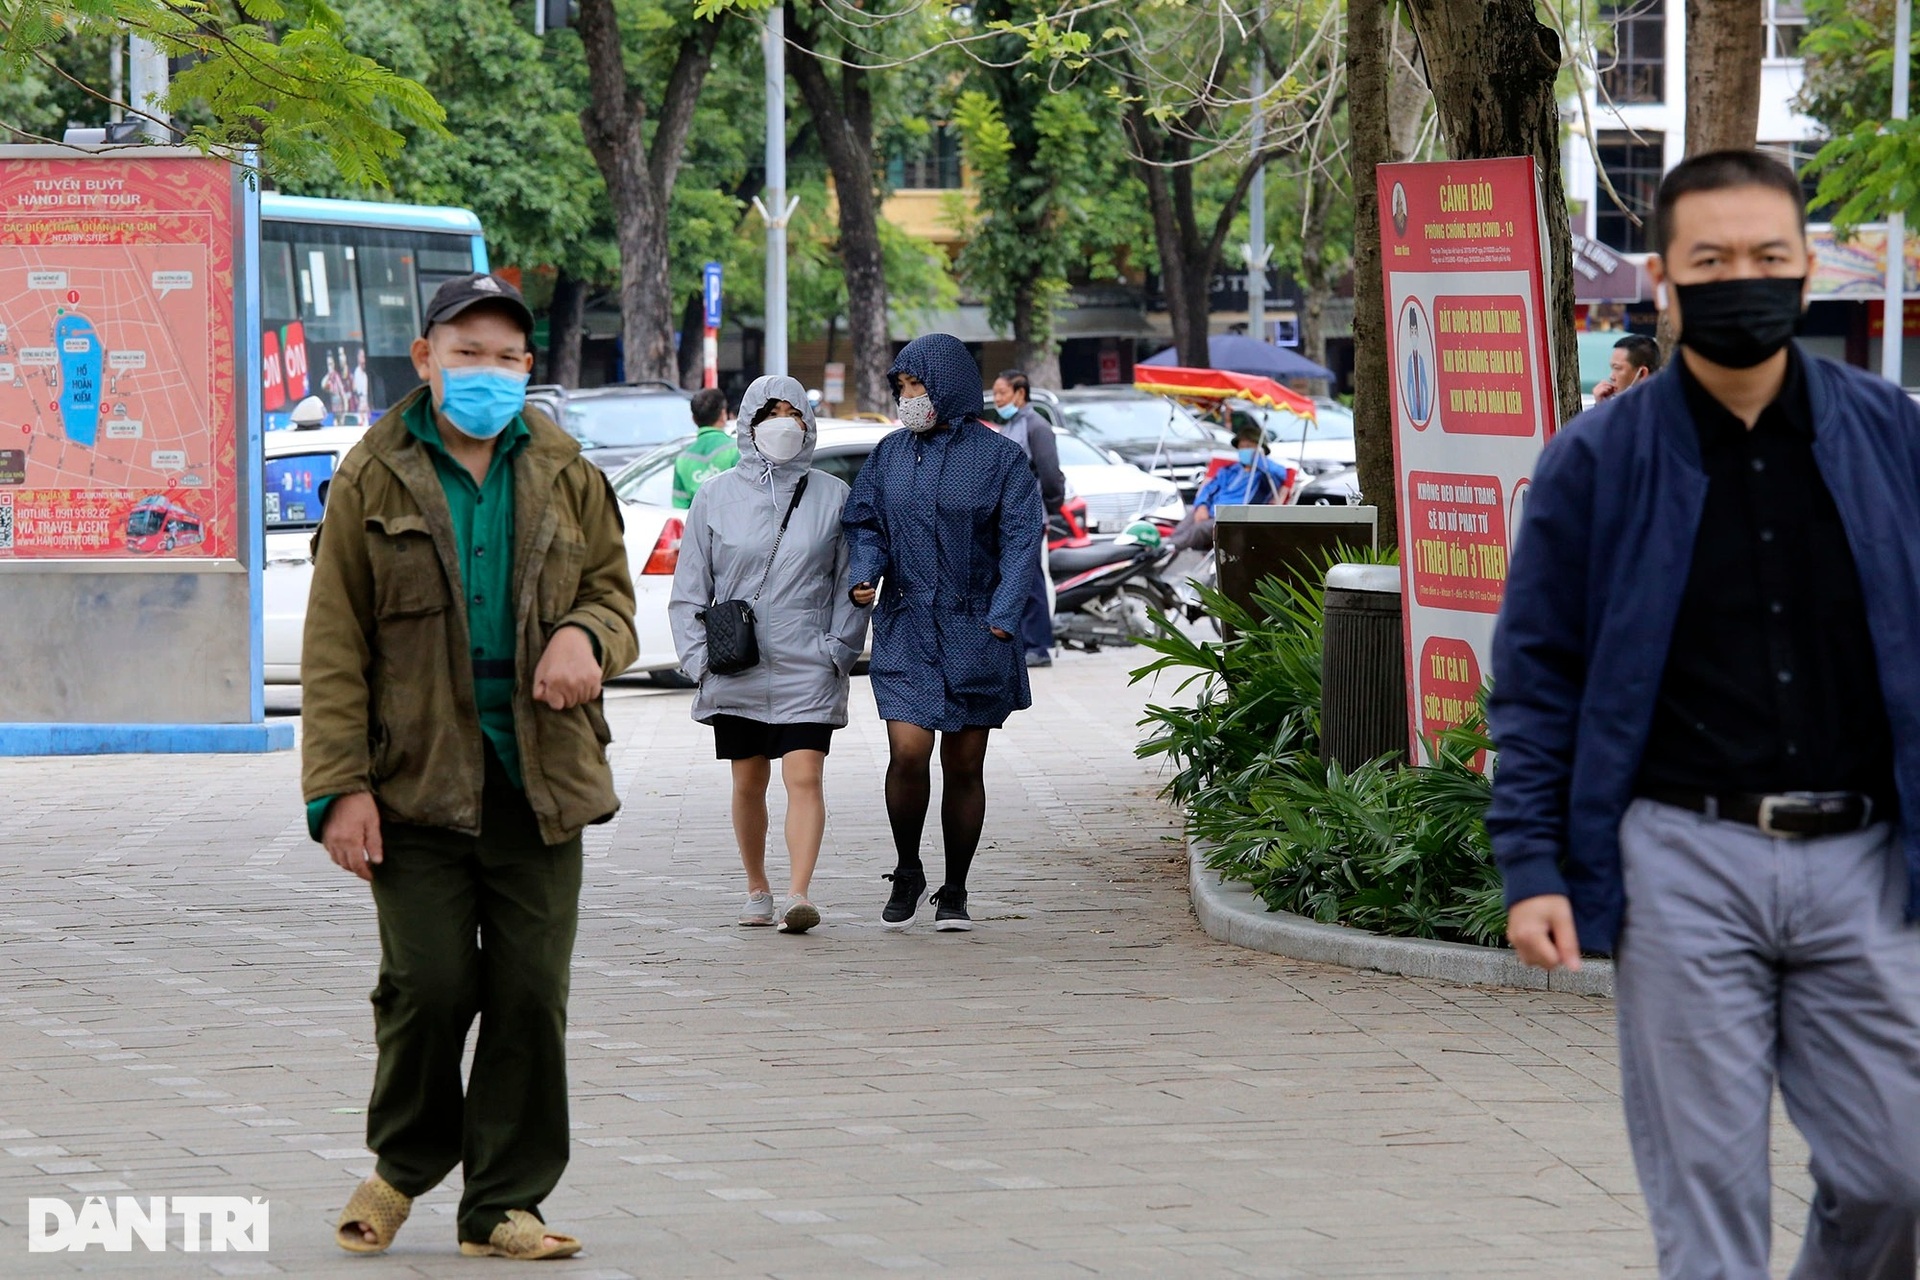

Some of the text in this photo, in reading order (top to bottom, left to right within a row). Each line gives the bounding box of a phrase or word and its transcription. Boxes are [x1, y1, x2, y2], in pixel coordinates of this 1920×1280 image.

[33, 177, 125, 191] TUYẾN BUÝT
[1440, 175, 1493, 212] CẢNH BÁO
[18, 194, 141, 205] HANOI CITY TOUR
[1482, 221, 1501, 238] COVID
[1505, 221, 1514, 238] 19
[709, 274, 720, 315] P
[1417, 481, 1439, 501] KHÔNG
[1454, 480, 1473, 504] KHẨU
[1474, 487, 1496, 505] TRANG
[18, 521, 110, 533] VIA TRAVEL AGENT
[1438, 511, 1447, 534] BỊ
[1458, 513, 1477, 537] PHẠT
[1415, 535, 1506, 587] 1 TRIỆU đến 3 TRIỆU
[1431, 647, 1469, 683] TẤT CẢ VÌ
[1424, 689, 1440, 721] SỨC
[1442, 693, 1463, 724] KHỎE
